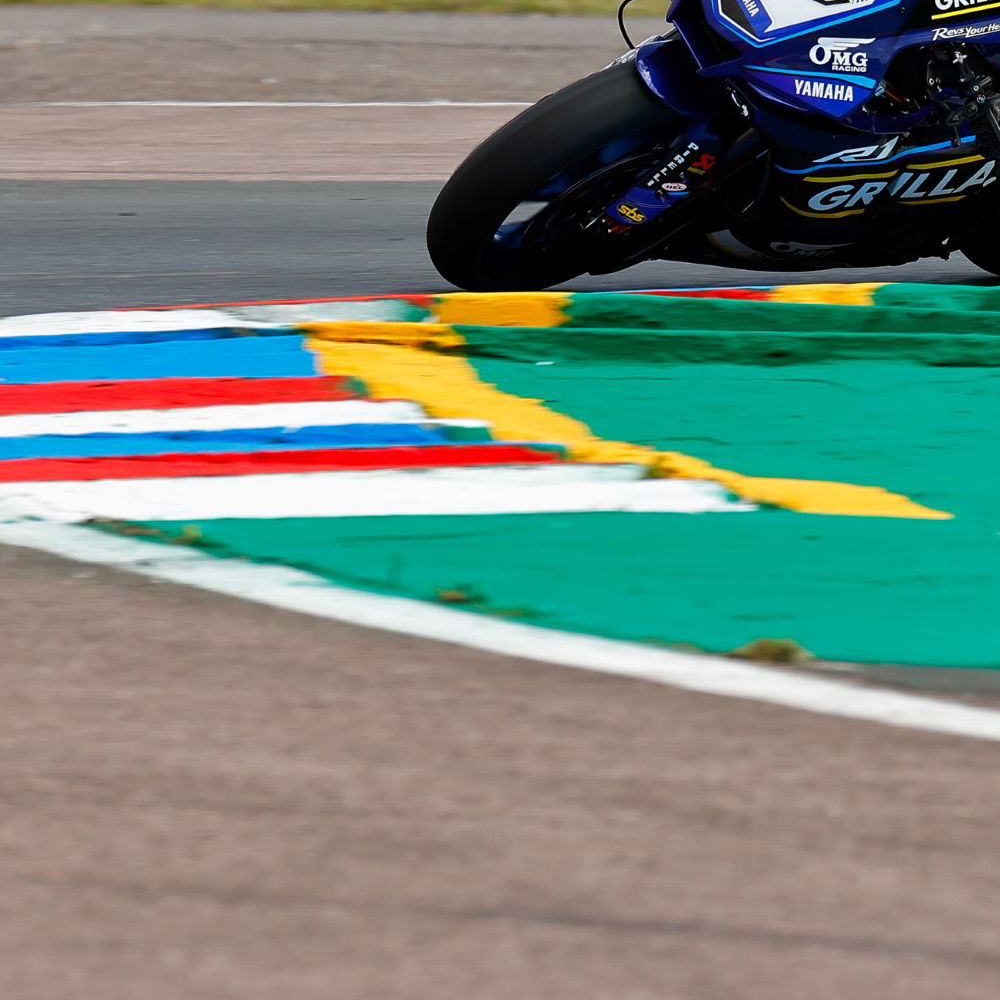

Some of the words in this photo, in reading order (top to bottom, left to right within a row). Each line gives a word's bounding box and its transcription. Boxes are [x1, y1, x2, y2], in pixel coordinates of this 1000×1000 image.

[809, 43, 869, 67] OMG
[831, 65, 868, 73] RACING
[794, 79, 854, 101] YAMAHA
[813, 136, 899, 163] R1
[647, 142, 699, 187] PIRELLI
[618, 205, 646, 223] sbs
